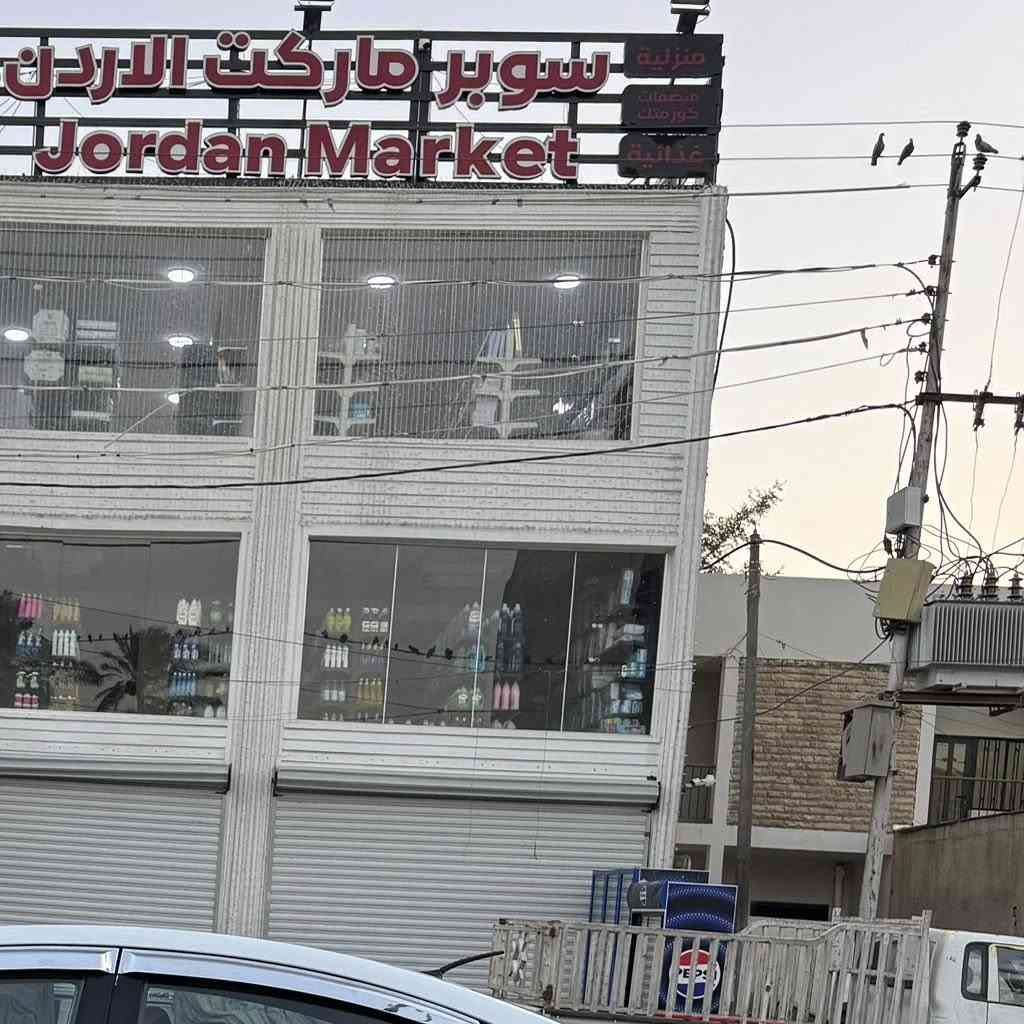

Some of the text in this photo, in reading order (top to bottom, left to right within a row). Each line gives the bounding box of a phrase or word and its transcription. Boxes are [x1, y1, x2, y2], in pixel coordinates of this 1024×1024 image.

[3, 30, 610, 111] سوبر ماركت الاردن
[637, 47, 705, 71] منزلية
[33, 119, 581, 180] Jordan Market
